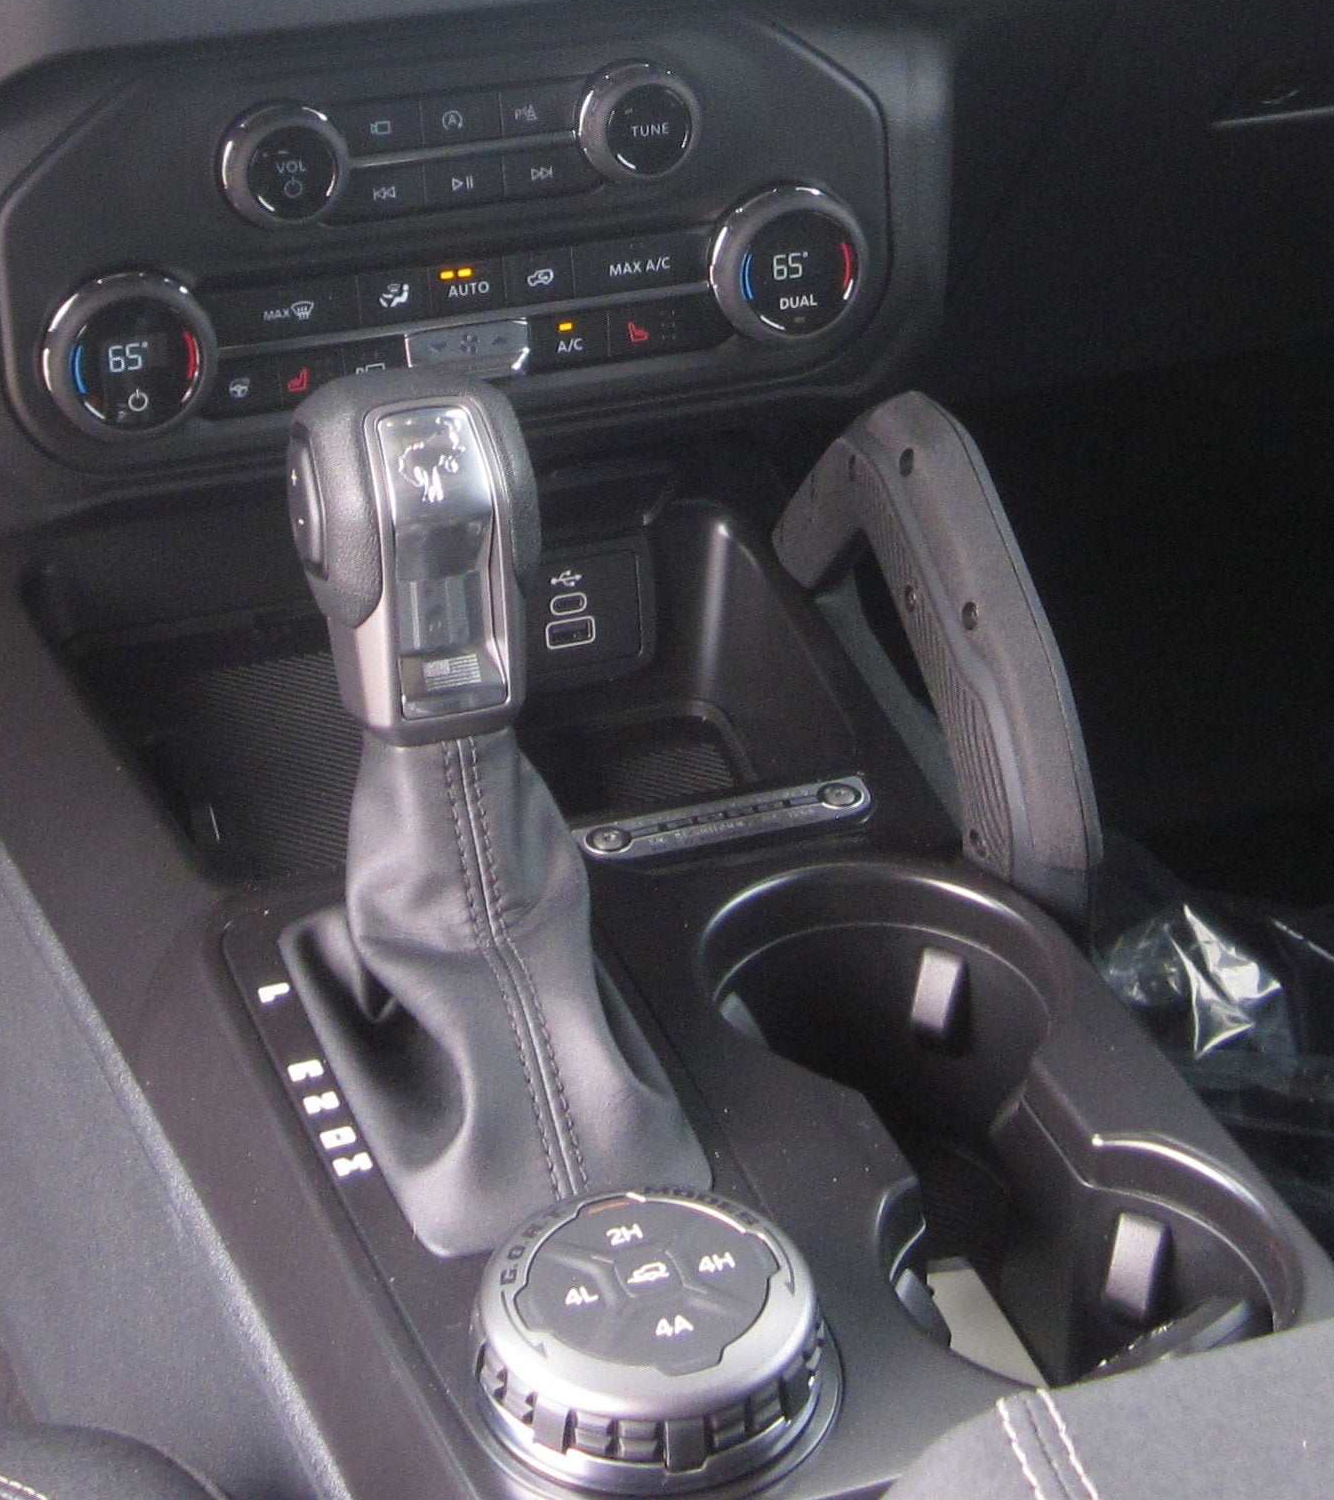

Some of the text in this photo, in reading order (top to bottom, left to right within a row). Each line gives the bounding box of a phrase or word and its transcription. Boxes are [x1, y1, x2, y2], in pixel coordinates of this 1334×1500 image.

[630, 122, 670, 137] TUNE
[276, 160, 307, 174] VOL
[609, 256, 671, 276] MAX A/C
[772, 251, 809, 281] 65°
[447, 281, 491, 298] AUTO
[779, 293, 818, 310] DUAL
[263, 308, 290, 321] MAX
[557, 338, 584, 354] A/C
[107, 341, 148, 374] 65°
[258, 982, 290, 1003] P
[303, 1090, 340, 1115] N
[332, 1151, 373, 1177] M
[606, 1223, 644, 1246] 2H
[698, 1251, 736, 1275] 4H
[565, 1286, 599, 1307] 4L
[655, 1314, 695, 1337] 4A
